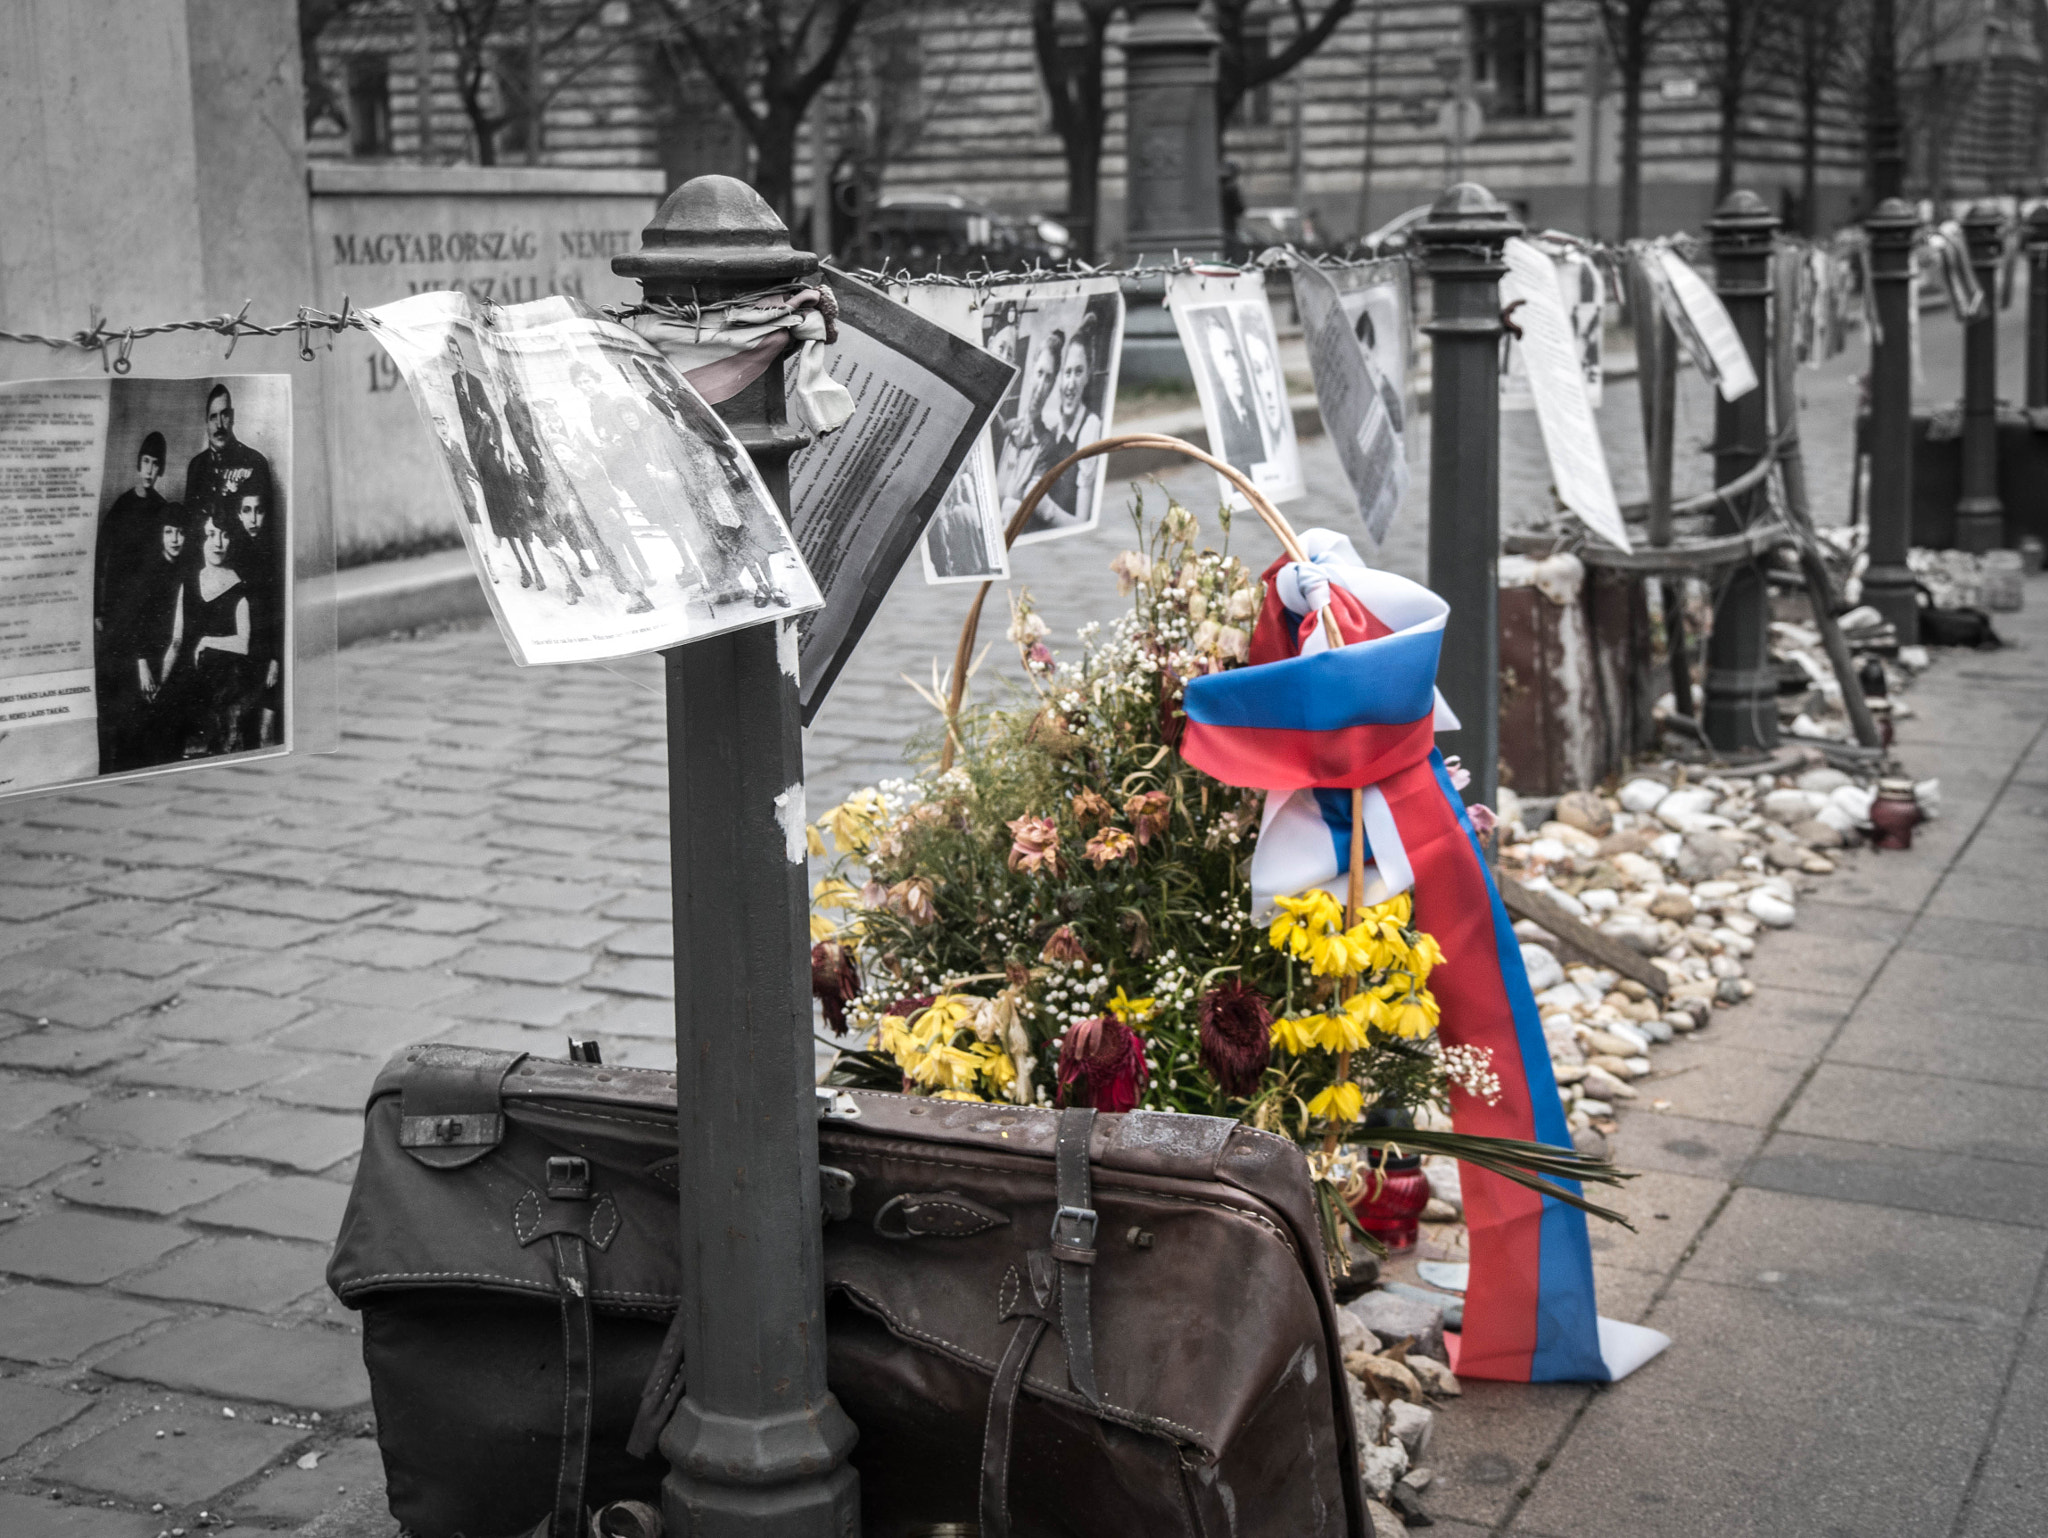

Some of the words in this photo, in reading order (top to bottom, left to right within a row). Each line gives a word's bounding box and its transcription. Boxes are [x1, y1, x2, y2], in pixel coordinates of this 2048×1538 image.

[332, 226, 538, 266] MAGYARORSZÁG
[890, 455, 903, 472] Nagy
[40, 689, 57, 698] LAJOS
[28, 708, 46, 718] LAJOS
